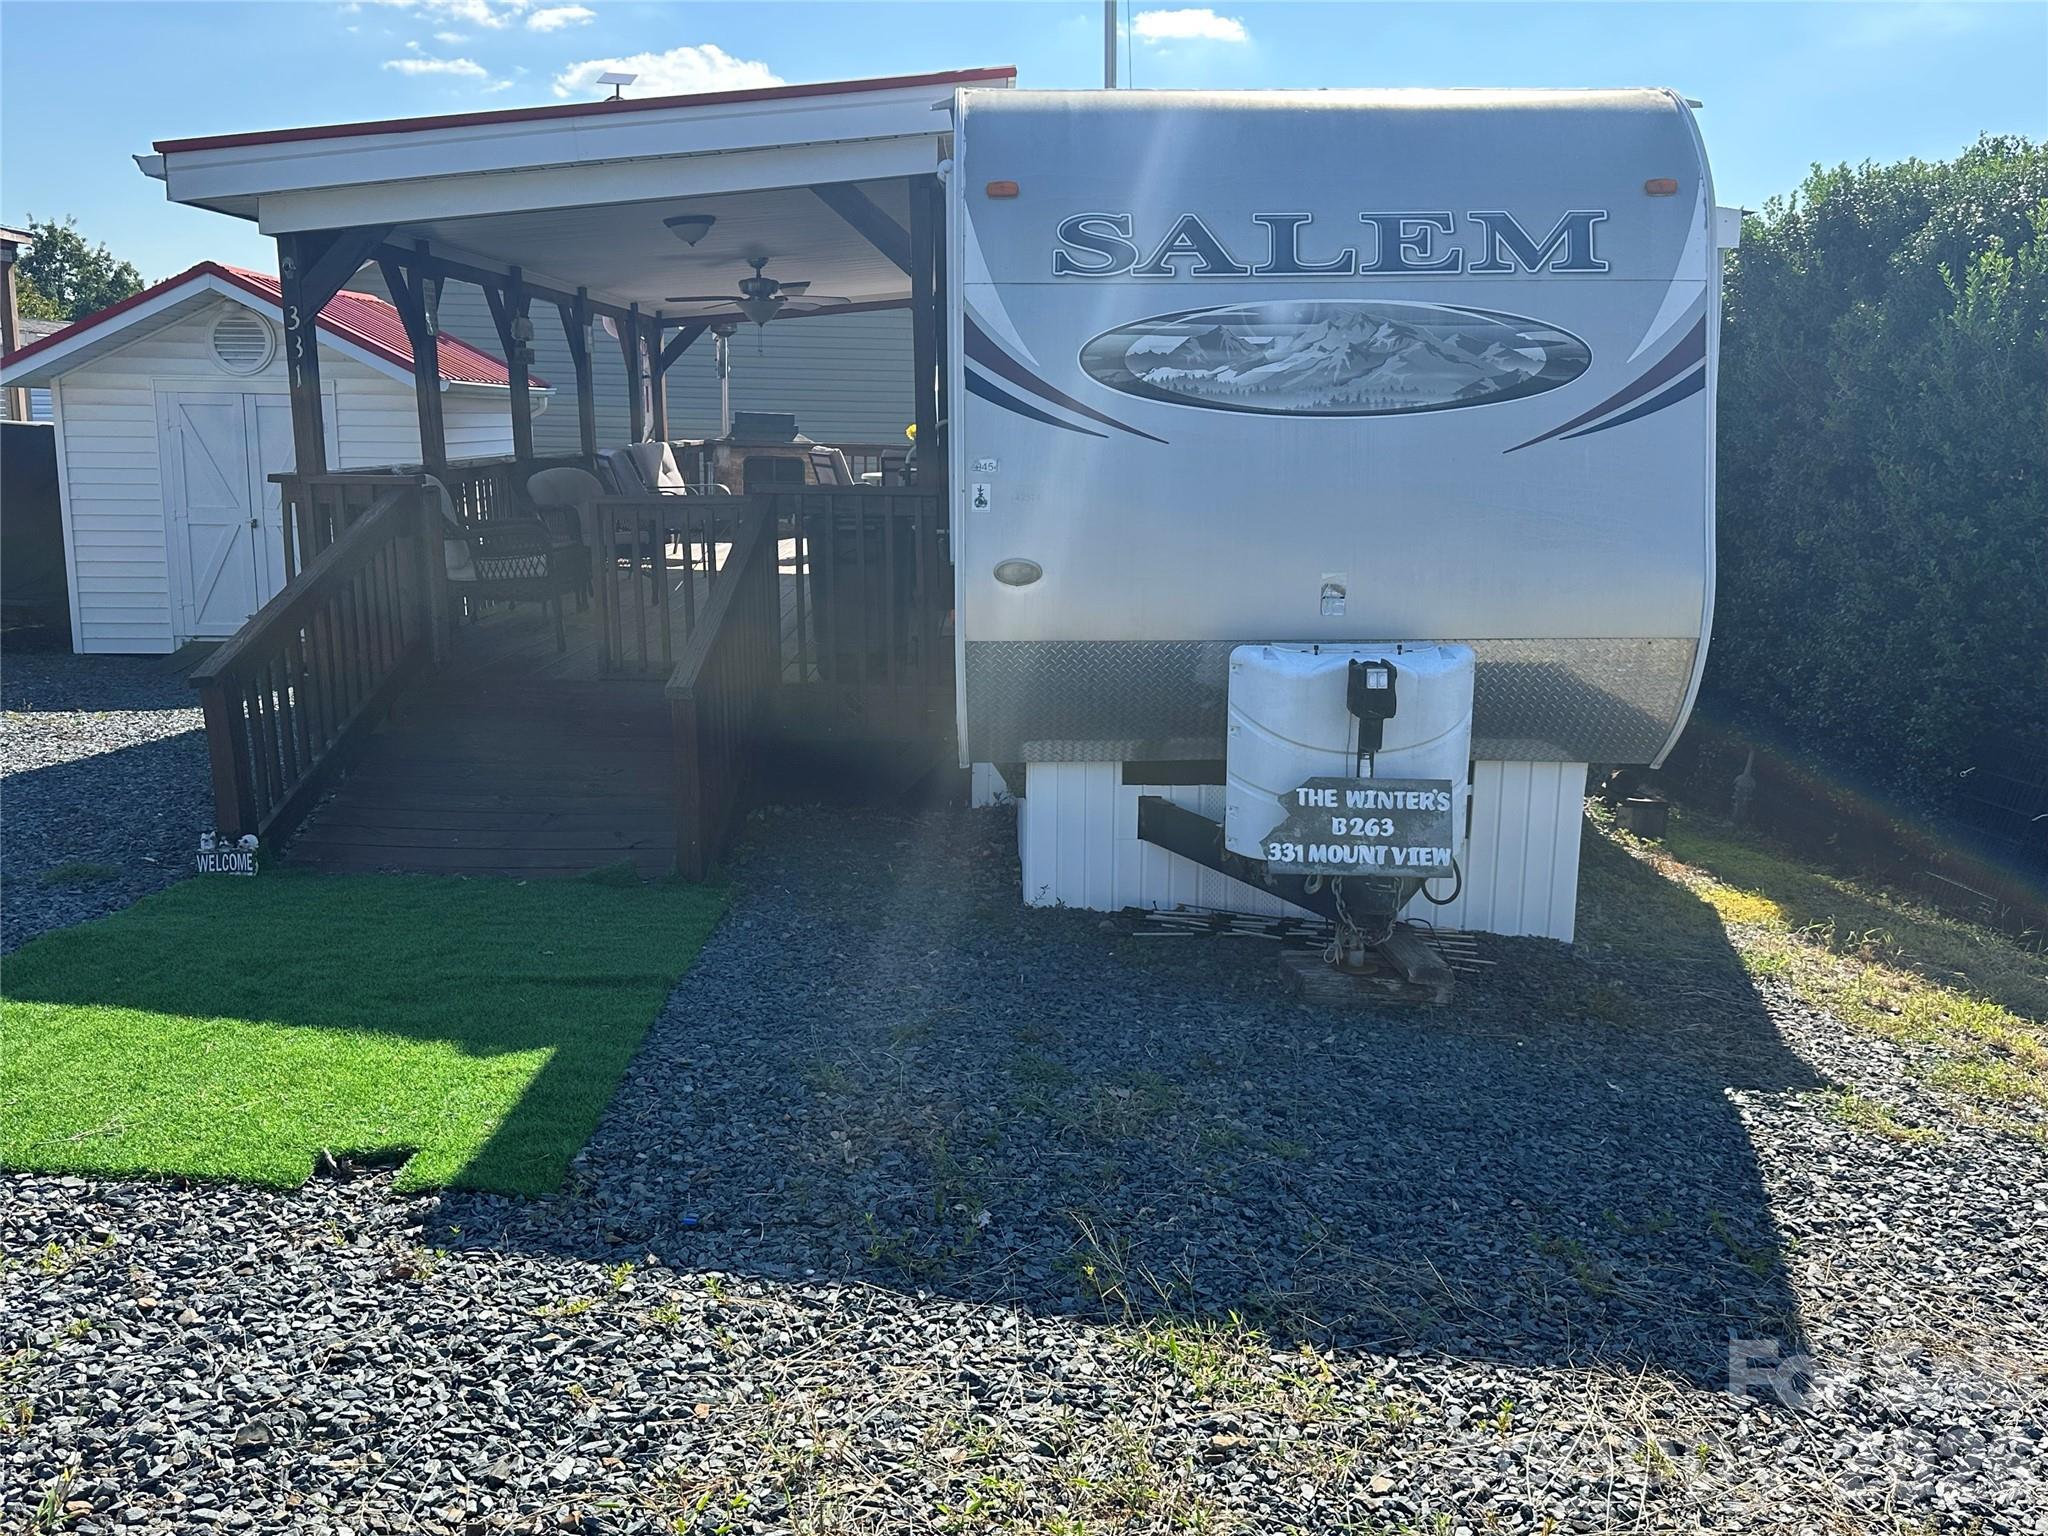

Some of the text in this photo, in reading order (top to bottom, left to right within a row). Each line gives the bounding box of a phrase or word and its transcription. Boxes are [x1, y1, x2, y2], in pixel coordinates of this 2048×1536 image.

[1052, 210, 1609, 277] SALEM
[286, 305, 304, 389] 331
[1295, 787, 1451, 812] THE WINTER'S
[196, 853, 253, 872] WELCOME
[1267, 842, 1451, 867] 331 MOUNT VIEW
